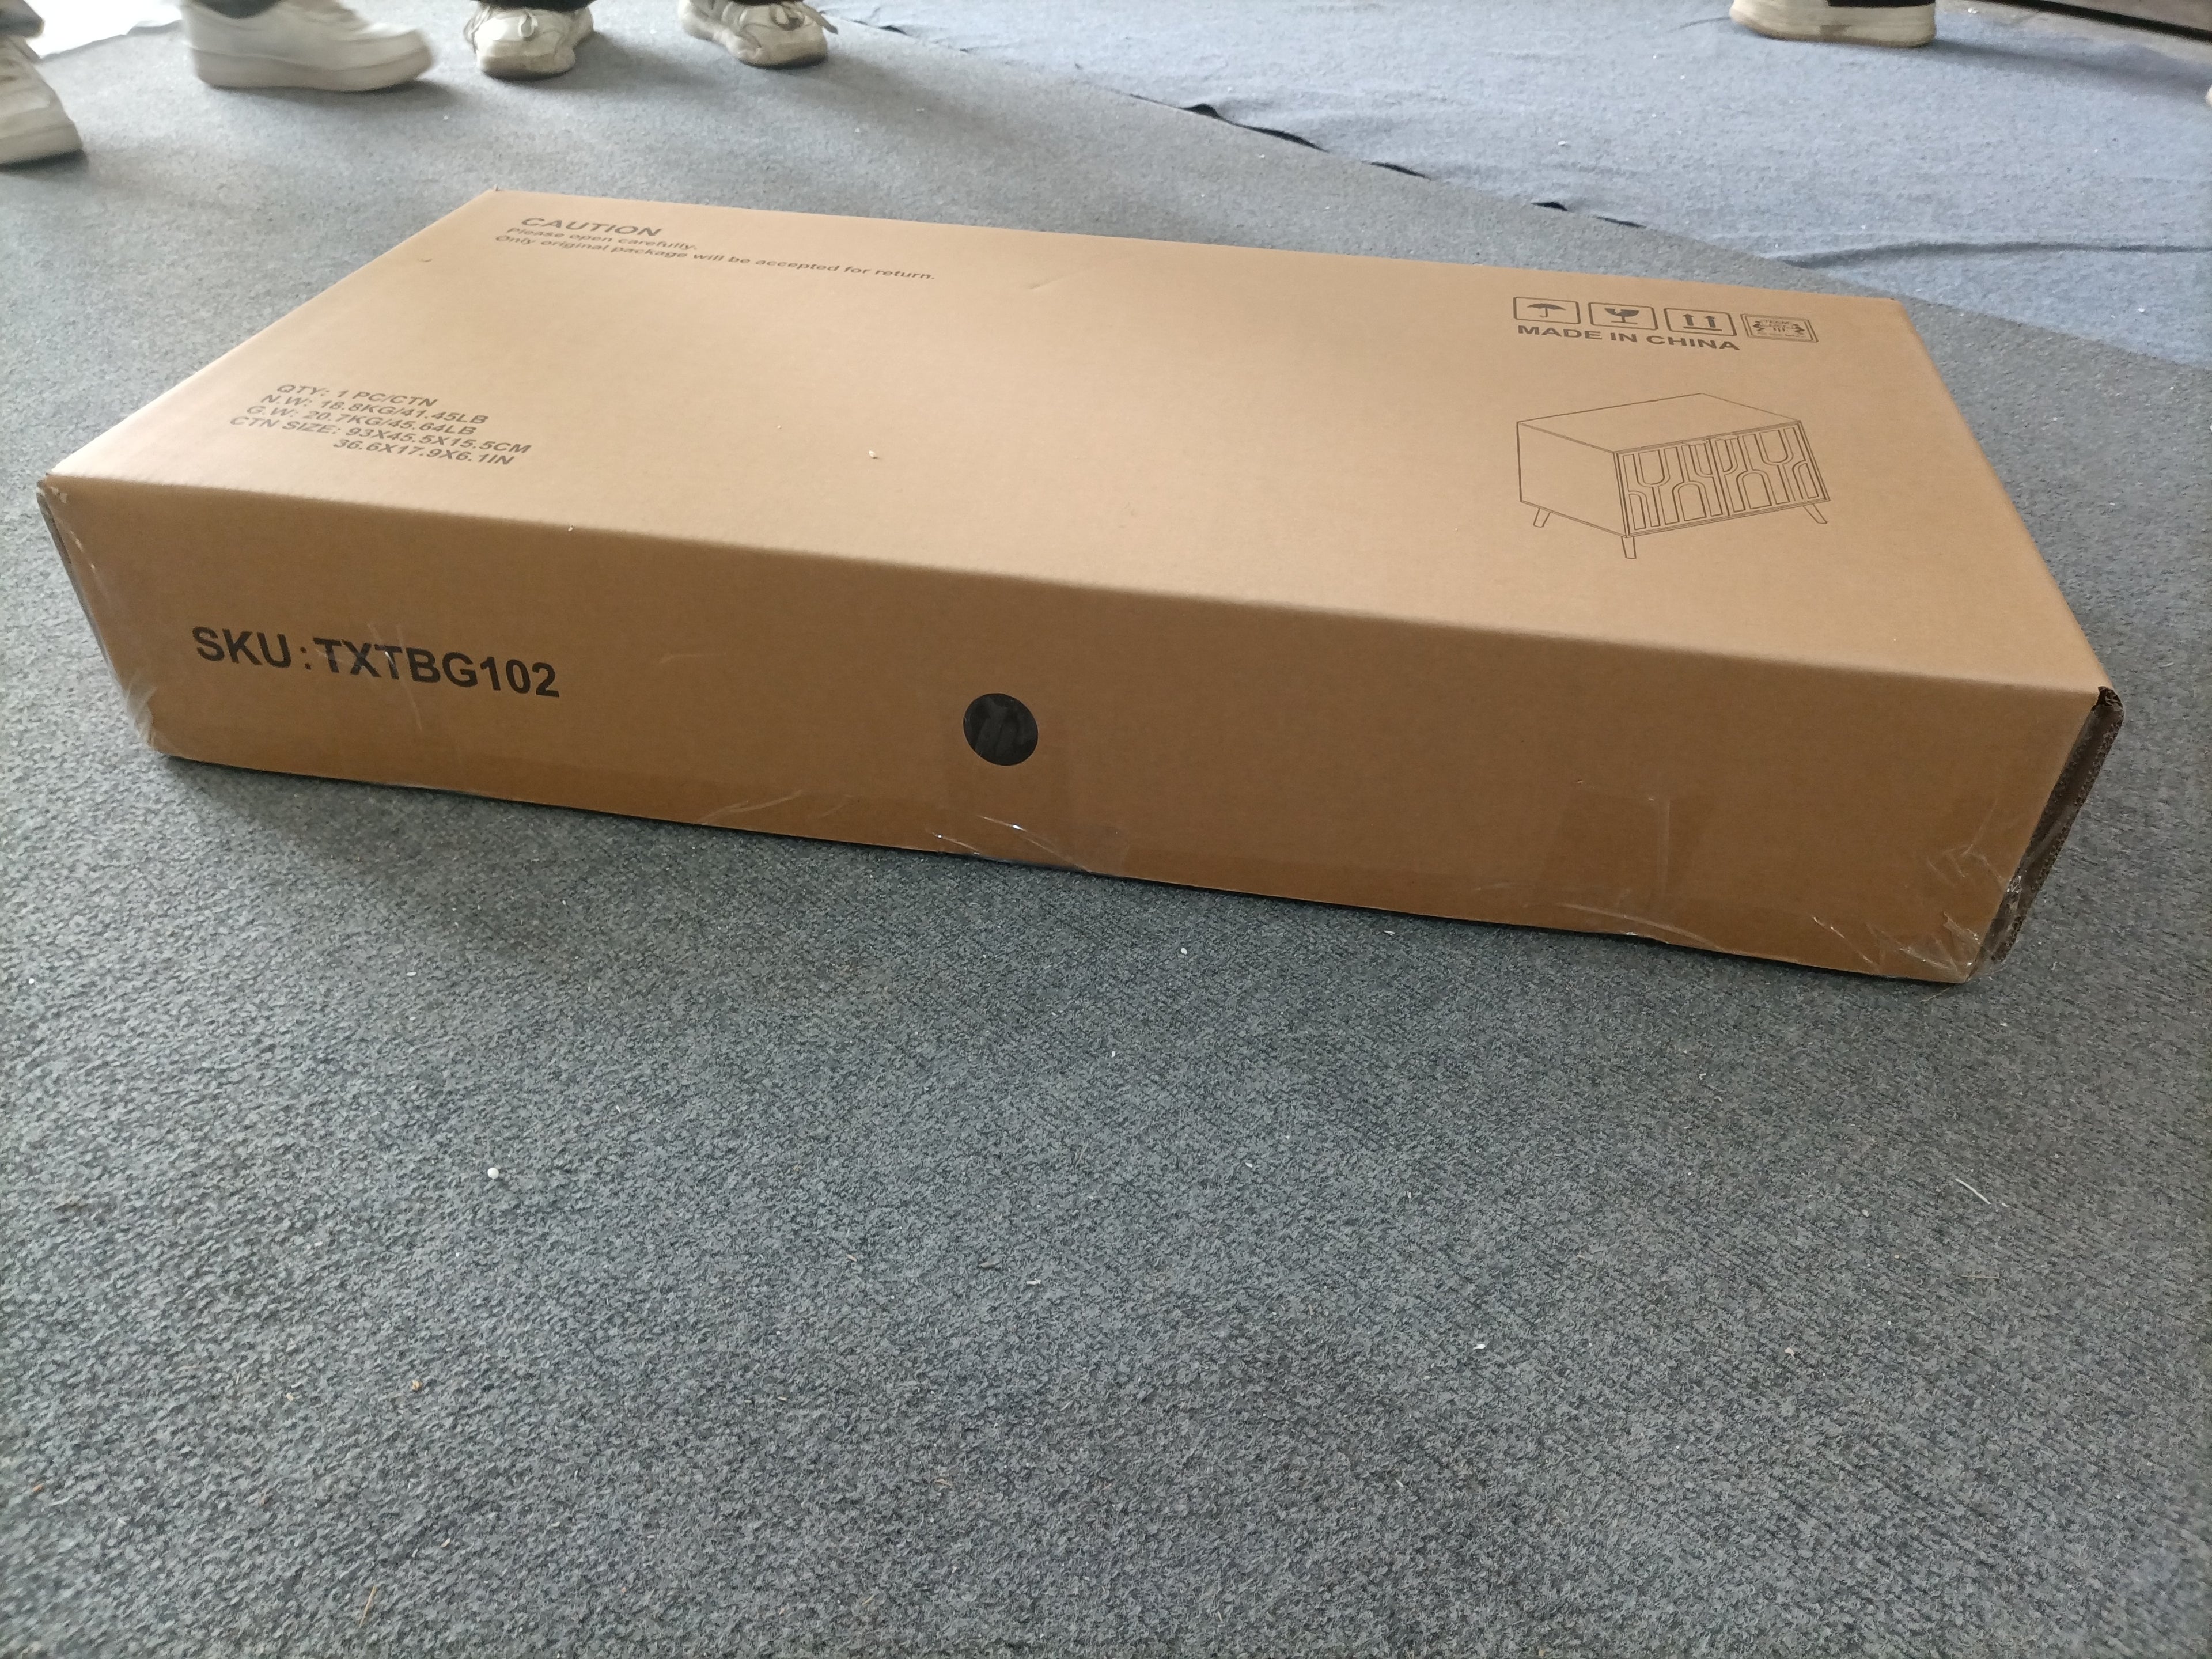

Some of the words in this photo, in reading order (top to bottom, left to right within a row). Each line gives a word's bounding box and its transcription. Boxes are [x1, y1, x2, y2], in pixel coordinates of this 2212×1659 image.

[506, 227, 565, 238] Please
[569, 234, 612, 243] open
[618, 237, 697, 251] carefully.
[521, 217, 662, 237] CAUTION
[495, 234, 536, 245] Only
[540, 240, 609, 251] original
[611, 245, 688, 259] package
[692, 253, 725, 262] will
[728, 256, 751, 264] be
[755, 259, 840, 272] accepted
[843, 266, 872, 274] for
[874, 268, 935, 280] return.
[1517, 325, 1603, 340] MADE
[1610, 332, 1638, 343] IN
[1645, 334, 1741, 351] CHINA
[260, 393, 313, 407] N.W:
[320, 400, 489, 424] 18.8KG/41.45LB
[276, 384, 330, 397] QTY:
[337, 389, 349, 398] 1
[352, 391, 439, 407] PC/CTN
[246, 405, 299, 418] G.W:
[302, 411, 478, 435] 20.7KG/45.64LB
[230, 416, 280, 428] CTN
[282, 421, 342, 434] SIZE:
[345, 427, 532, 454] 93X45.5X15.5CM
[333, 439, 515, 465] 36.6X17.9X6.1IN
